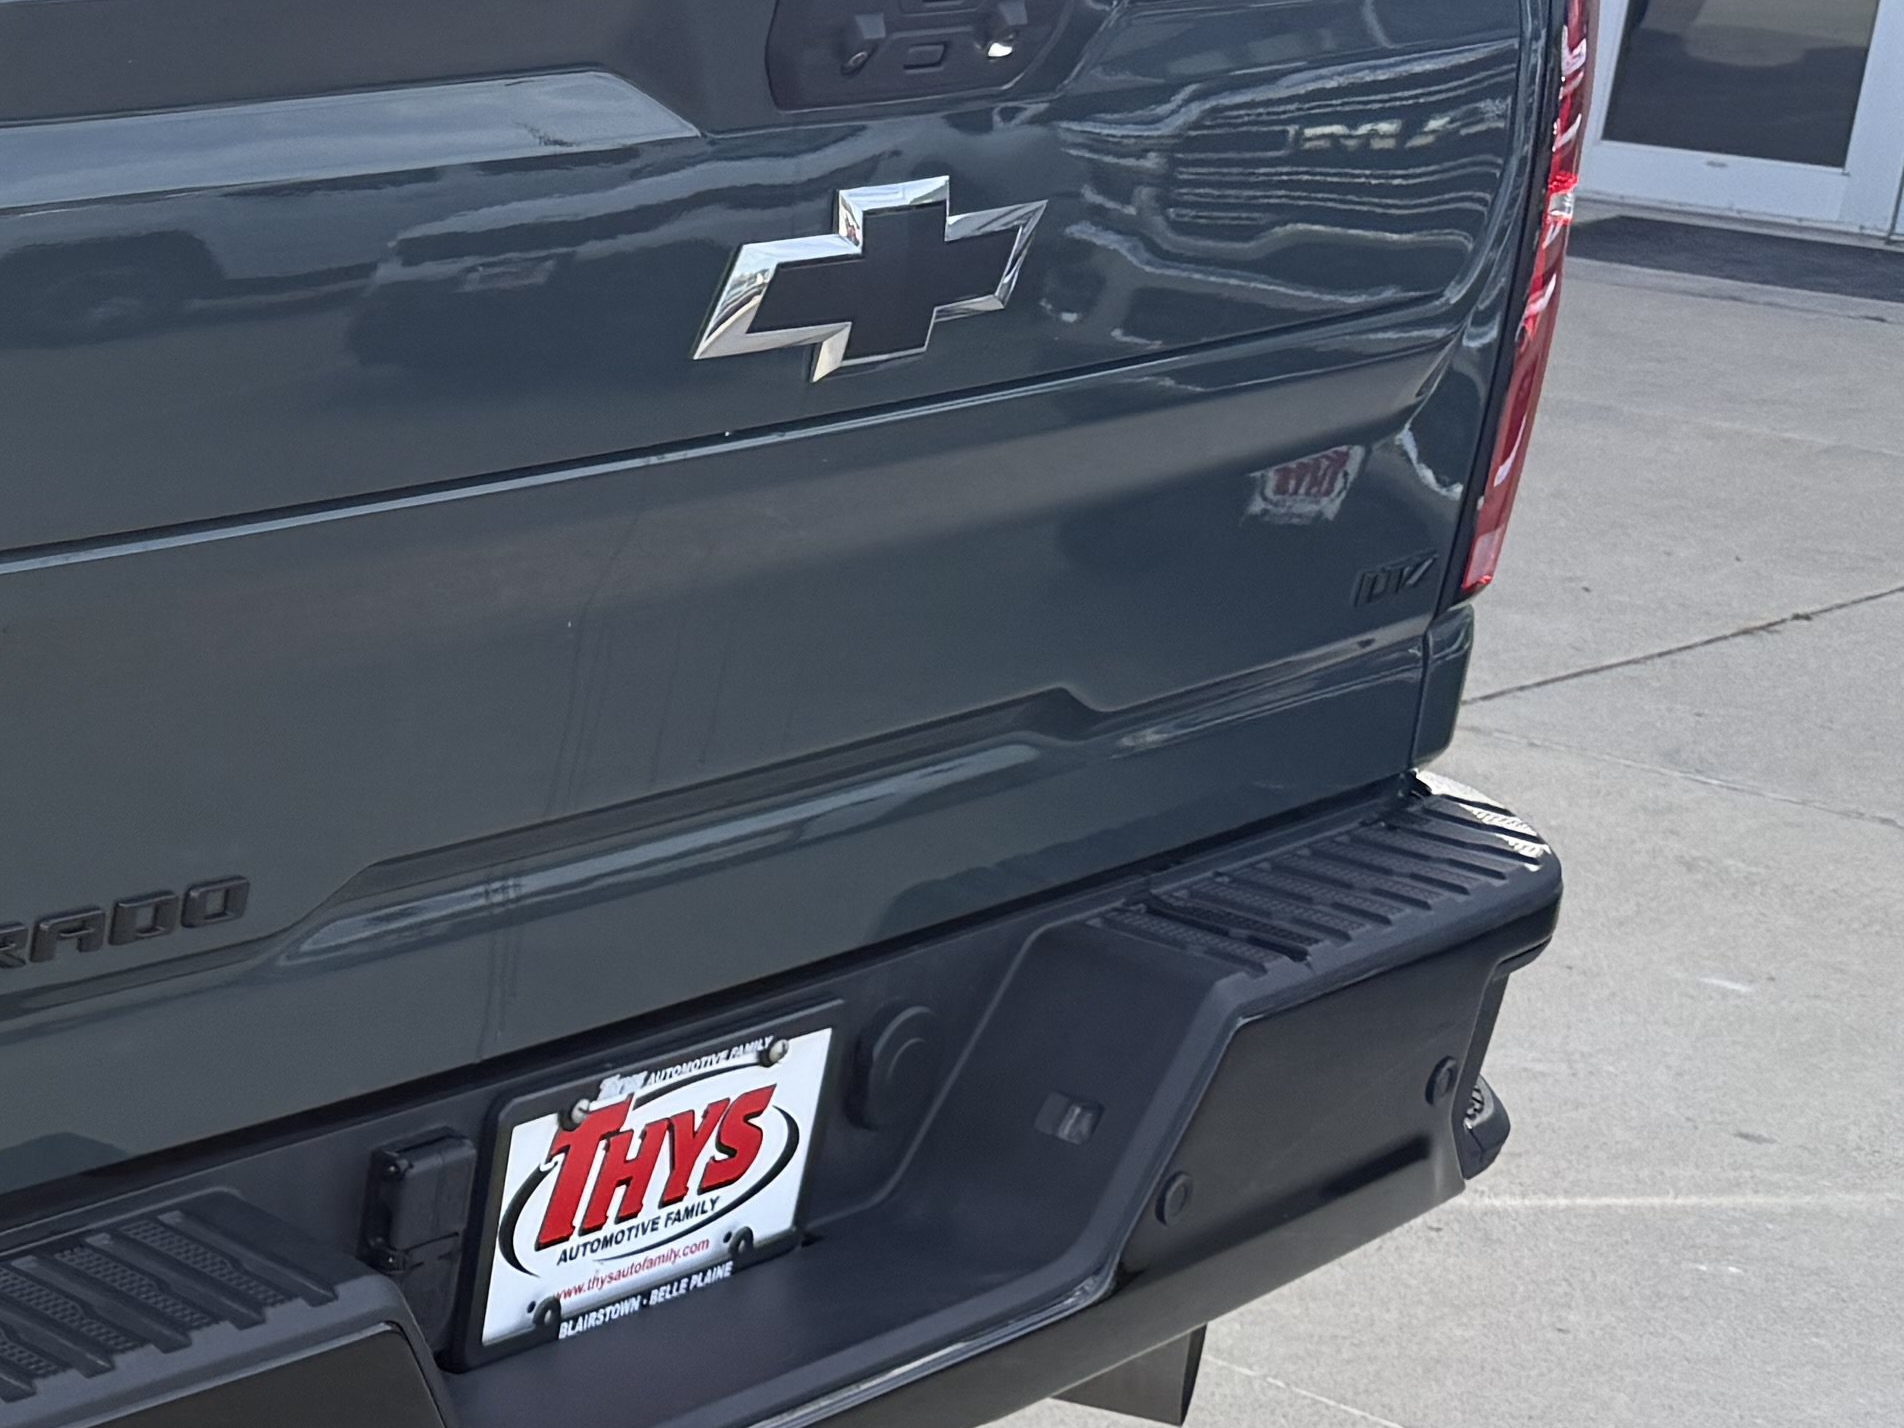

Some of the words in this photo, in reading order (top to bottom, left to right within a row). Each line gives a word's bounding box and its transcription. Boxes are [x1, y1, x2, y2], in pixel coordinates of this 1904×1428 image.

[647, 1049, 729, 1087] AUTOMOTIVE
[730, 1035, 775, 1061] FAMILY
[534, 1084, 777, 1252] THYS
[556, 1217, 661, 1266] AUTOMOTIVE
[664, 1195, 721, 1228] FAMILY
[554, 1238, 710, 1301] www.thysautofamily.com
[558, 1294, 642, 1340] BLAIRSTOWN
[649, 1277, 688, 1306] BELLE
[689, 1260, 734, 1289] PLAINE
